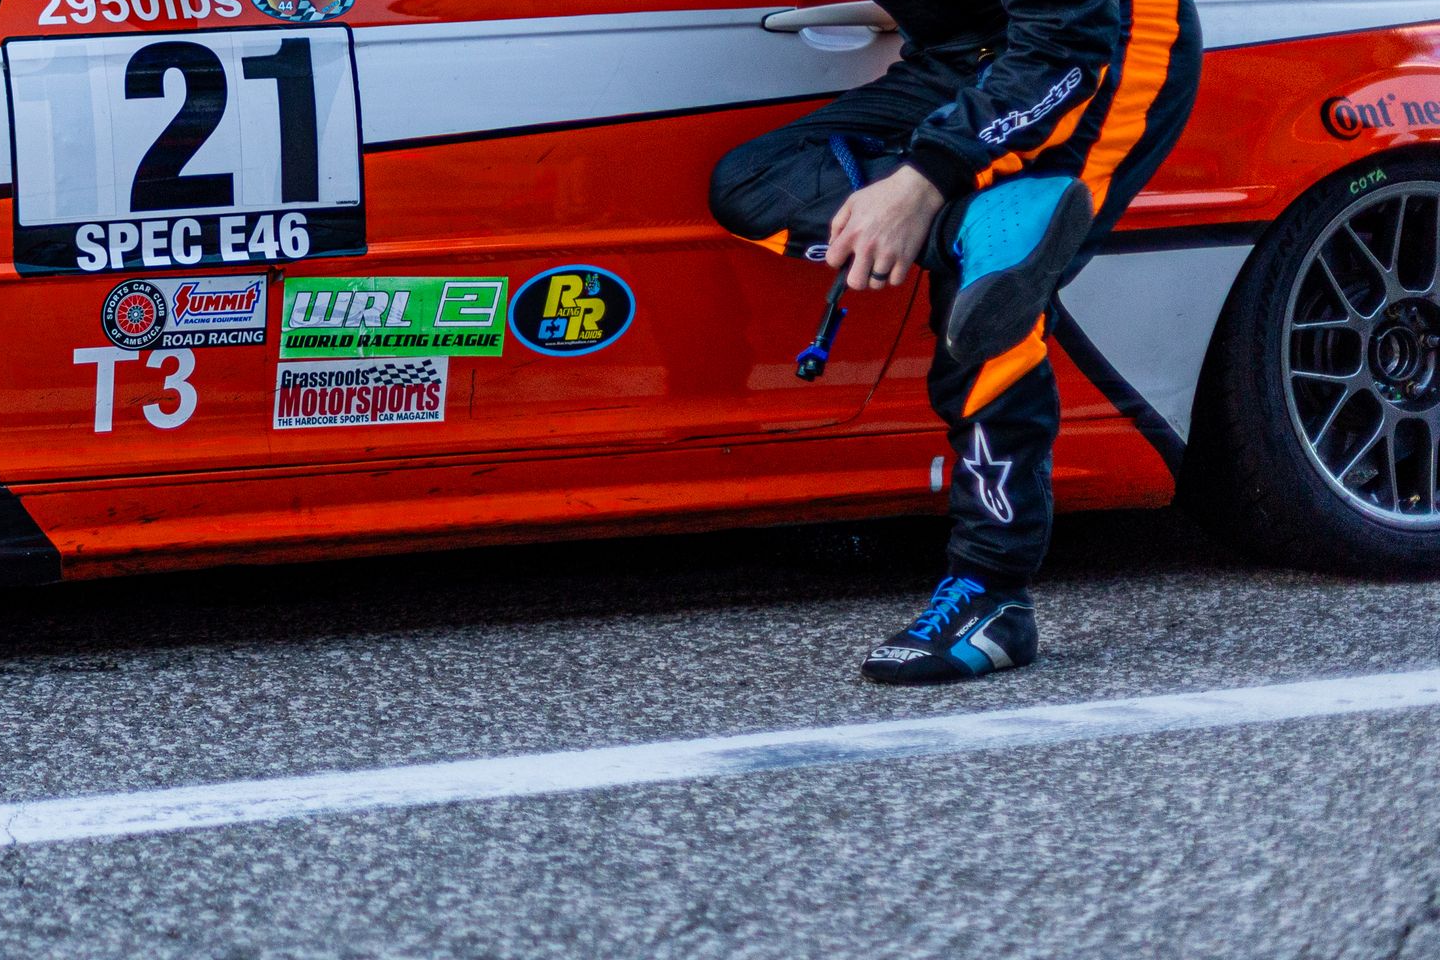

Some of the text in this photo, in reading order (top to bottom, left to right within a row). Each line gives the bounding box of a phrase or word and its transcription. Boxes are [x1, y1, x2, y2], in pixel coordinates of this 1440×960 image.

[278, 1, 293, 11] 44
[979, 67, 1083, 144] alpinestars
[124, 37, 320, 212] 21
[1349, 169, 1387, 195] COTA
[75, 213, 310, 272] SPEC E46
[106, 283, 165, 320] SPORTS CAR CLUB
[288, 291, 412, 328] WRL
[184, 316, 253, 325] RACING EQUIPMENT
[111, 325, 161, 345] OF AMERICA
[162, 330, 264, 347] ROAD RACING
[285, 333, 502, 349] WORLD RACING LEAGUE
[74, 346, 198, 433] T3
[281, 368, 370, 388] Grassroots
[278, 383, 441, 422] Motorsports
[278, 411, 440, 426] THE HARDCORE SPORTS CAR MAGAZINE
[955, 616, 980, 637] TECNICA
